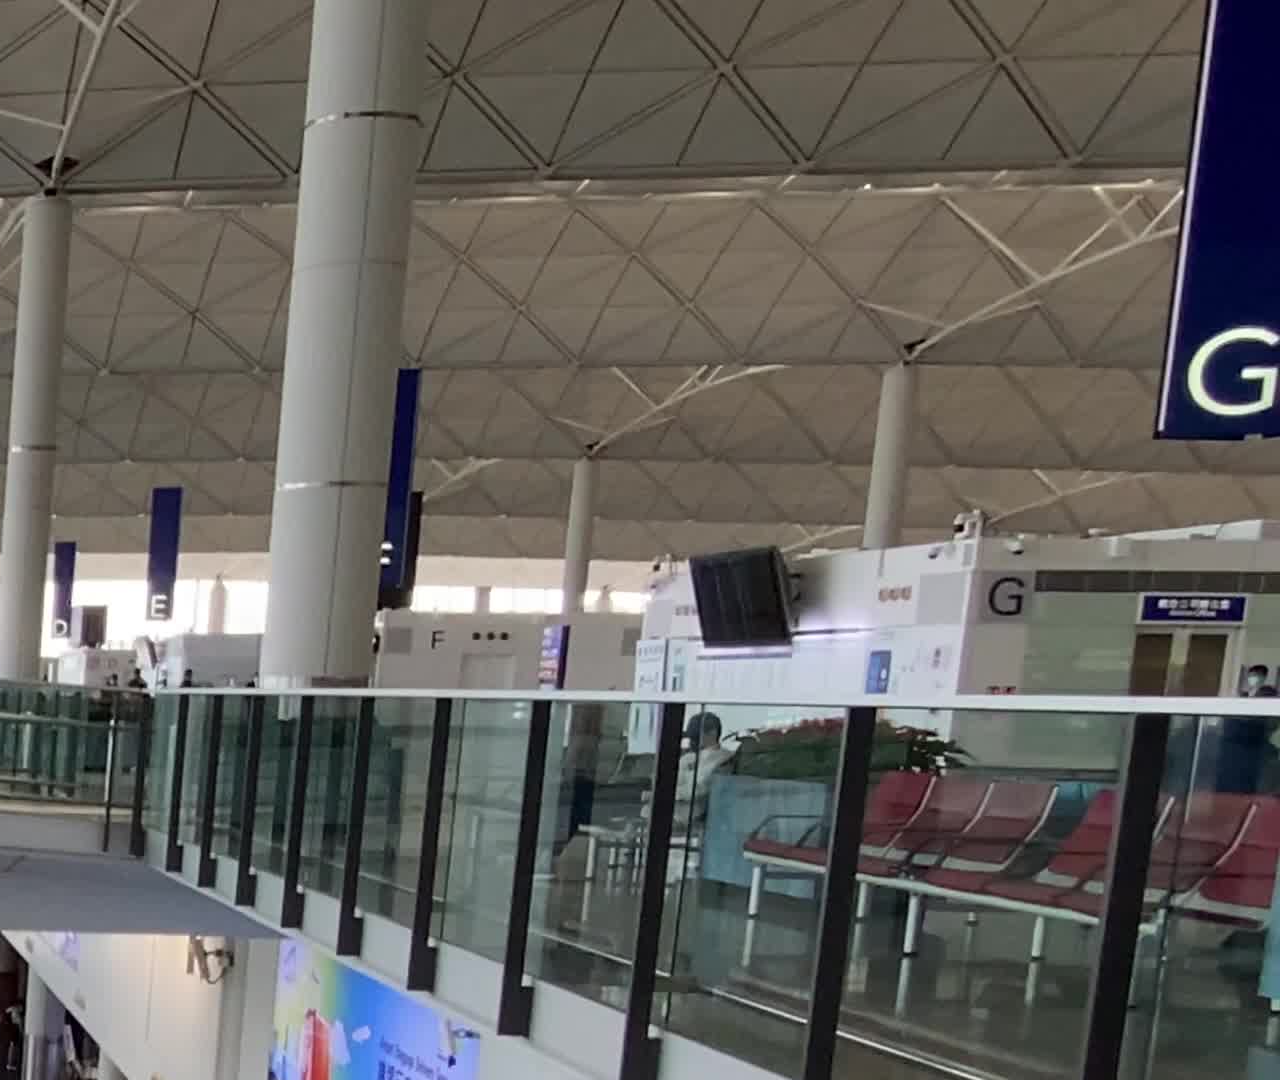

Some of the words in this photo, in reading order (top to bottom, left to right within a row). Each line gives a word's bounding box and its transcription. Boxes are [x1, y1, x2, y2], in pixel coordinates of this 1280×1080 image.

[1187, 326, 1279, 416] G
[150, 595, 168, 618] E
[988, 577, 1025, 616] G
[55, 619, 68, 637] D
[431, 630, 446, 649] F
